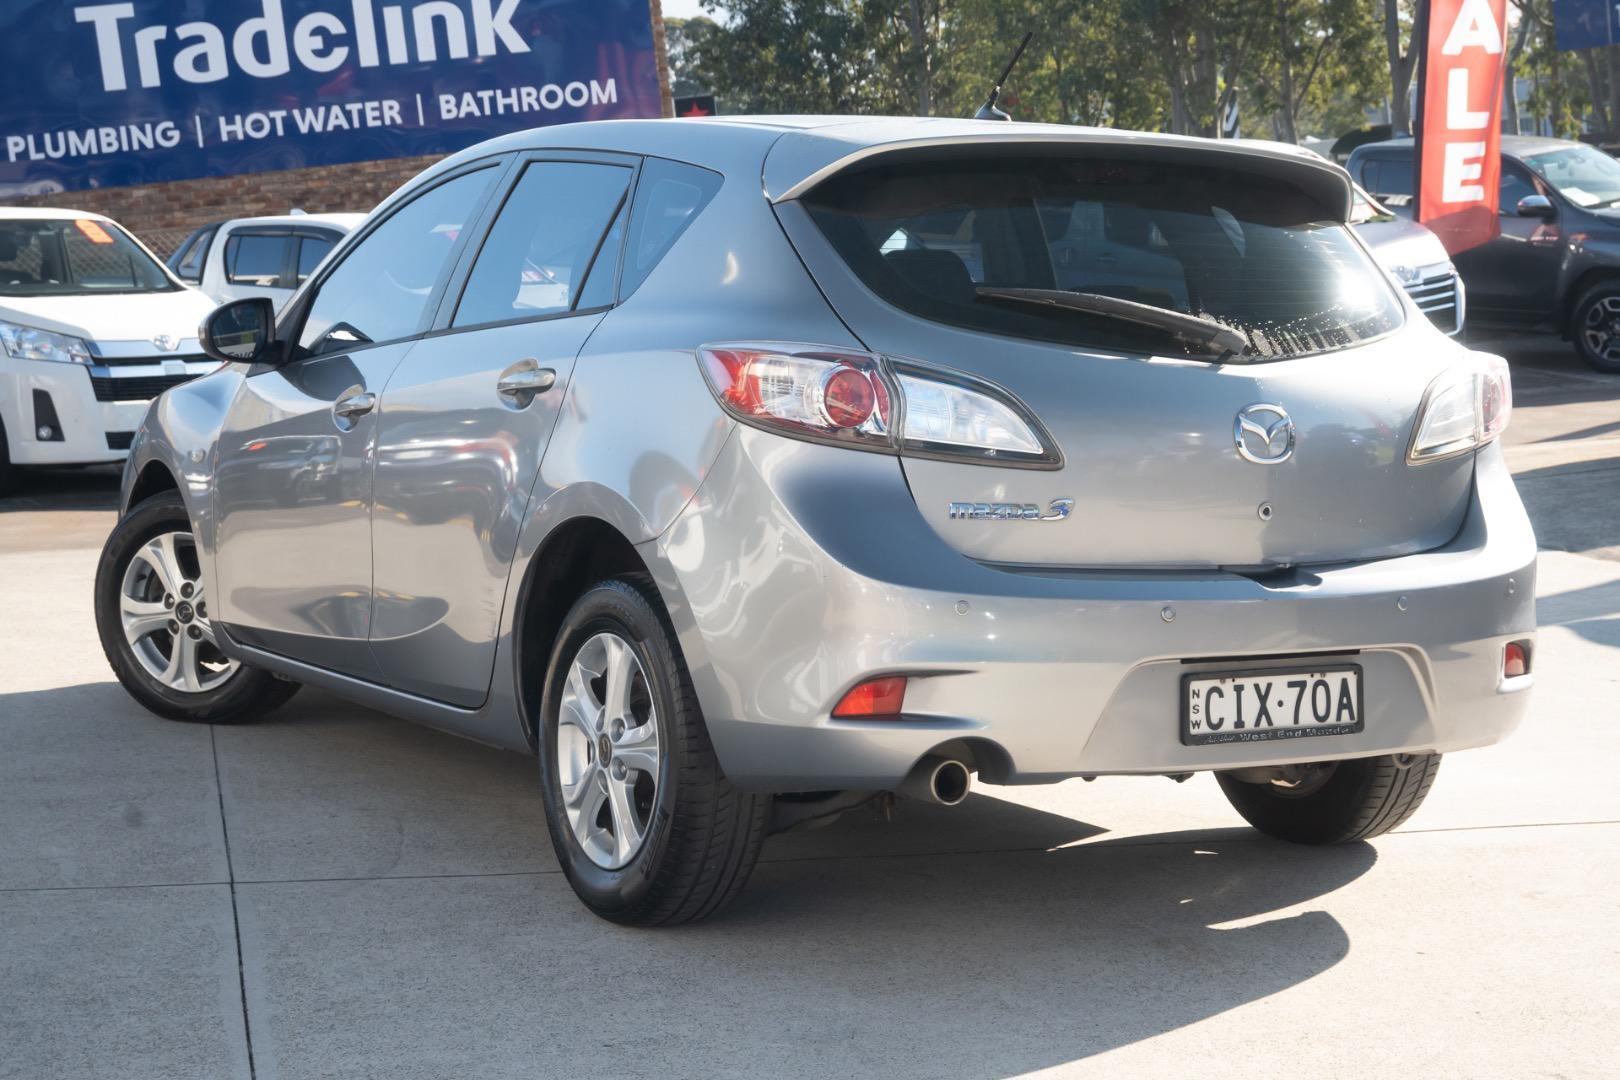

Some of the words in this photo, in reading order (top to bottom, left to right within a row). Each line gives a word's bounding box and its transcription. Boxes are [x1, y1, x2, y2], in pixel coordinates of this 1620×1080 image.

[74, 0, 531, 92] Tradelink
[6, 121, 181, 163] PLUMBING
[218, 110, 288, 142] HOT
[292, 99, 403, 134] WATER
[438, 78, 618, 120] BATHROOM
[1277, 729, 1302, 739] End
